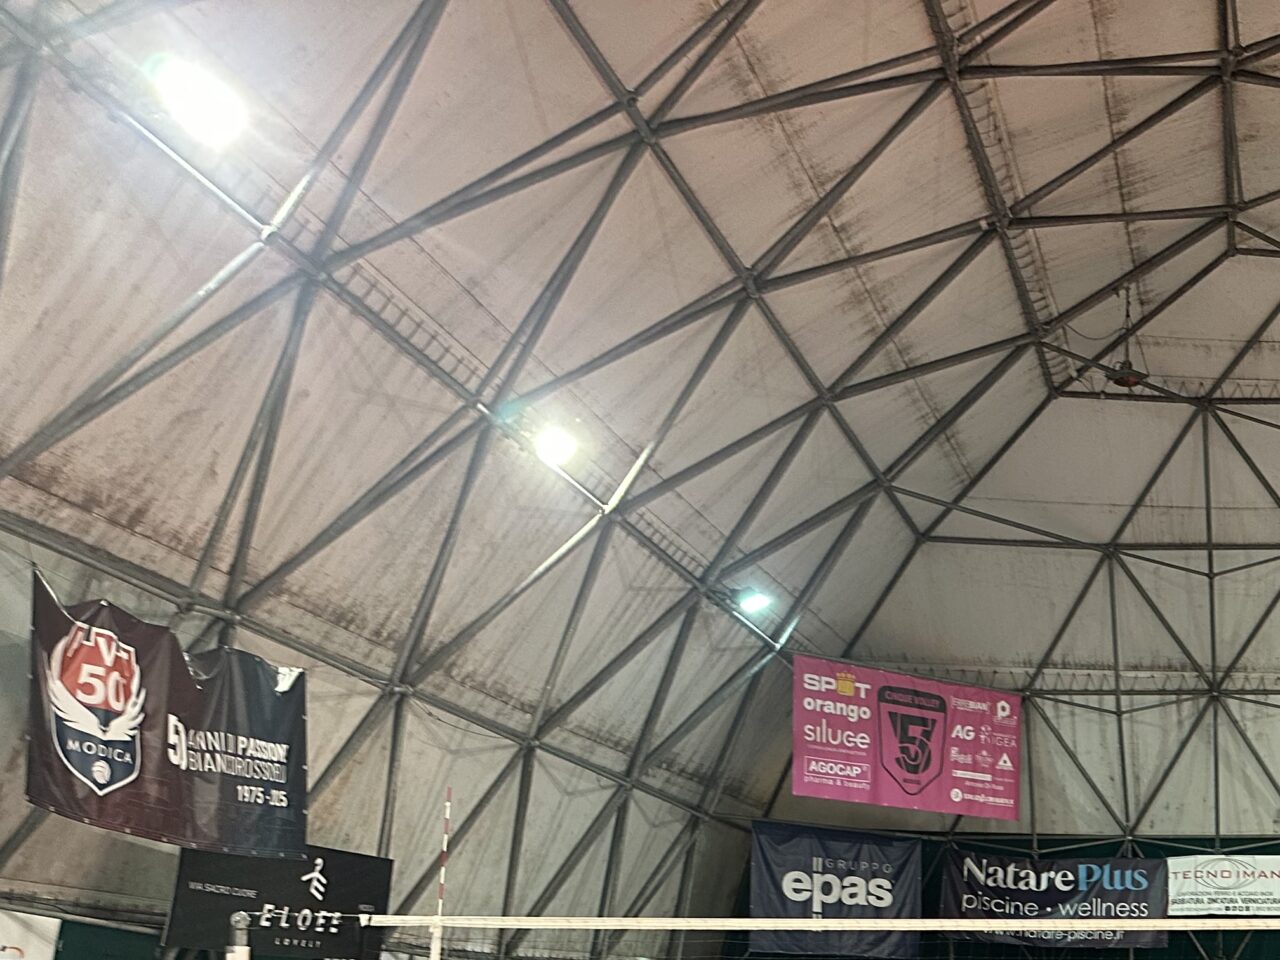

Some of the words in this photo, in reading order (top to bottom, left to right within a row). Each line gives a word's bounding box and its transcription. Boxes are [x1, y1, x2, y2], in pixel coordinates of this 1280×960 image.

[803, 697, 872, 722] orango
[951, 725, 976, 740] AG
[66, 738, 133, 764] MODICA
[809, 761, 862, 777] AGOCAP
[824, 858, 893, 874] GRUPPO
[782, 870, 894, 914] epas
[961, 891, 1039, 916] piscine
[1058, 898, 1149, 917] wellness
